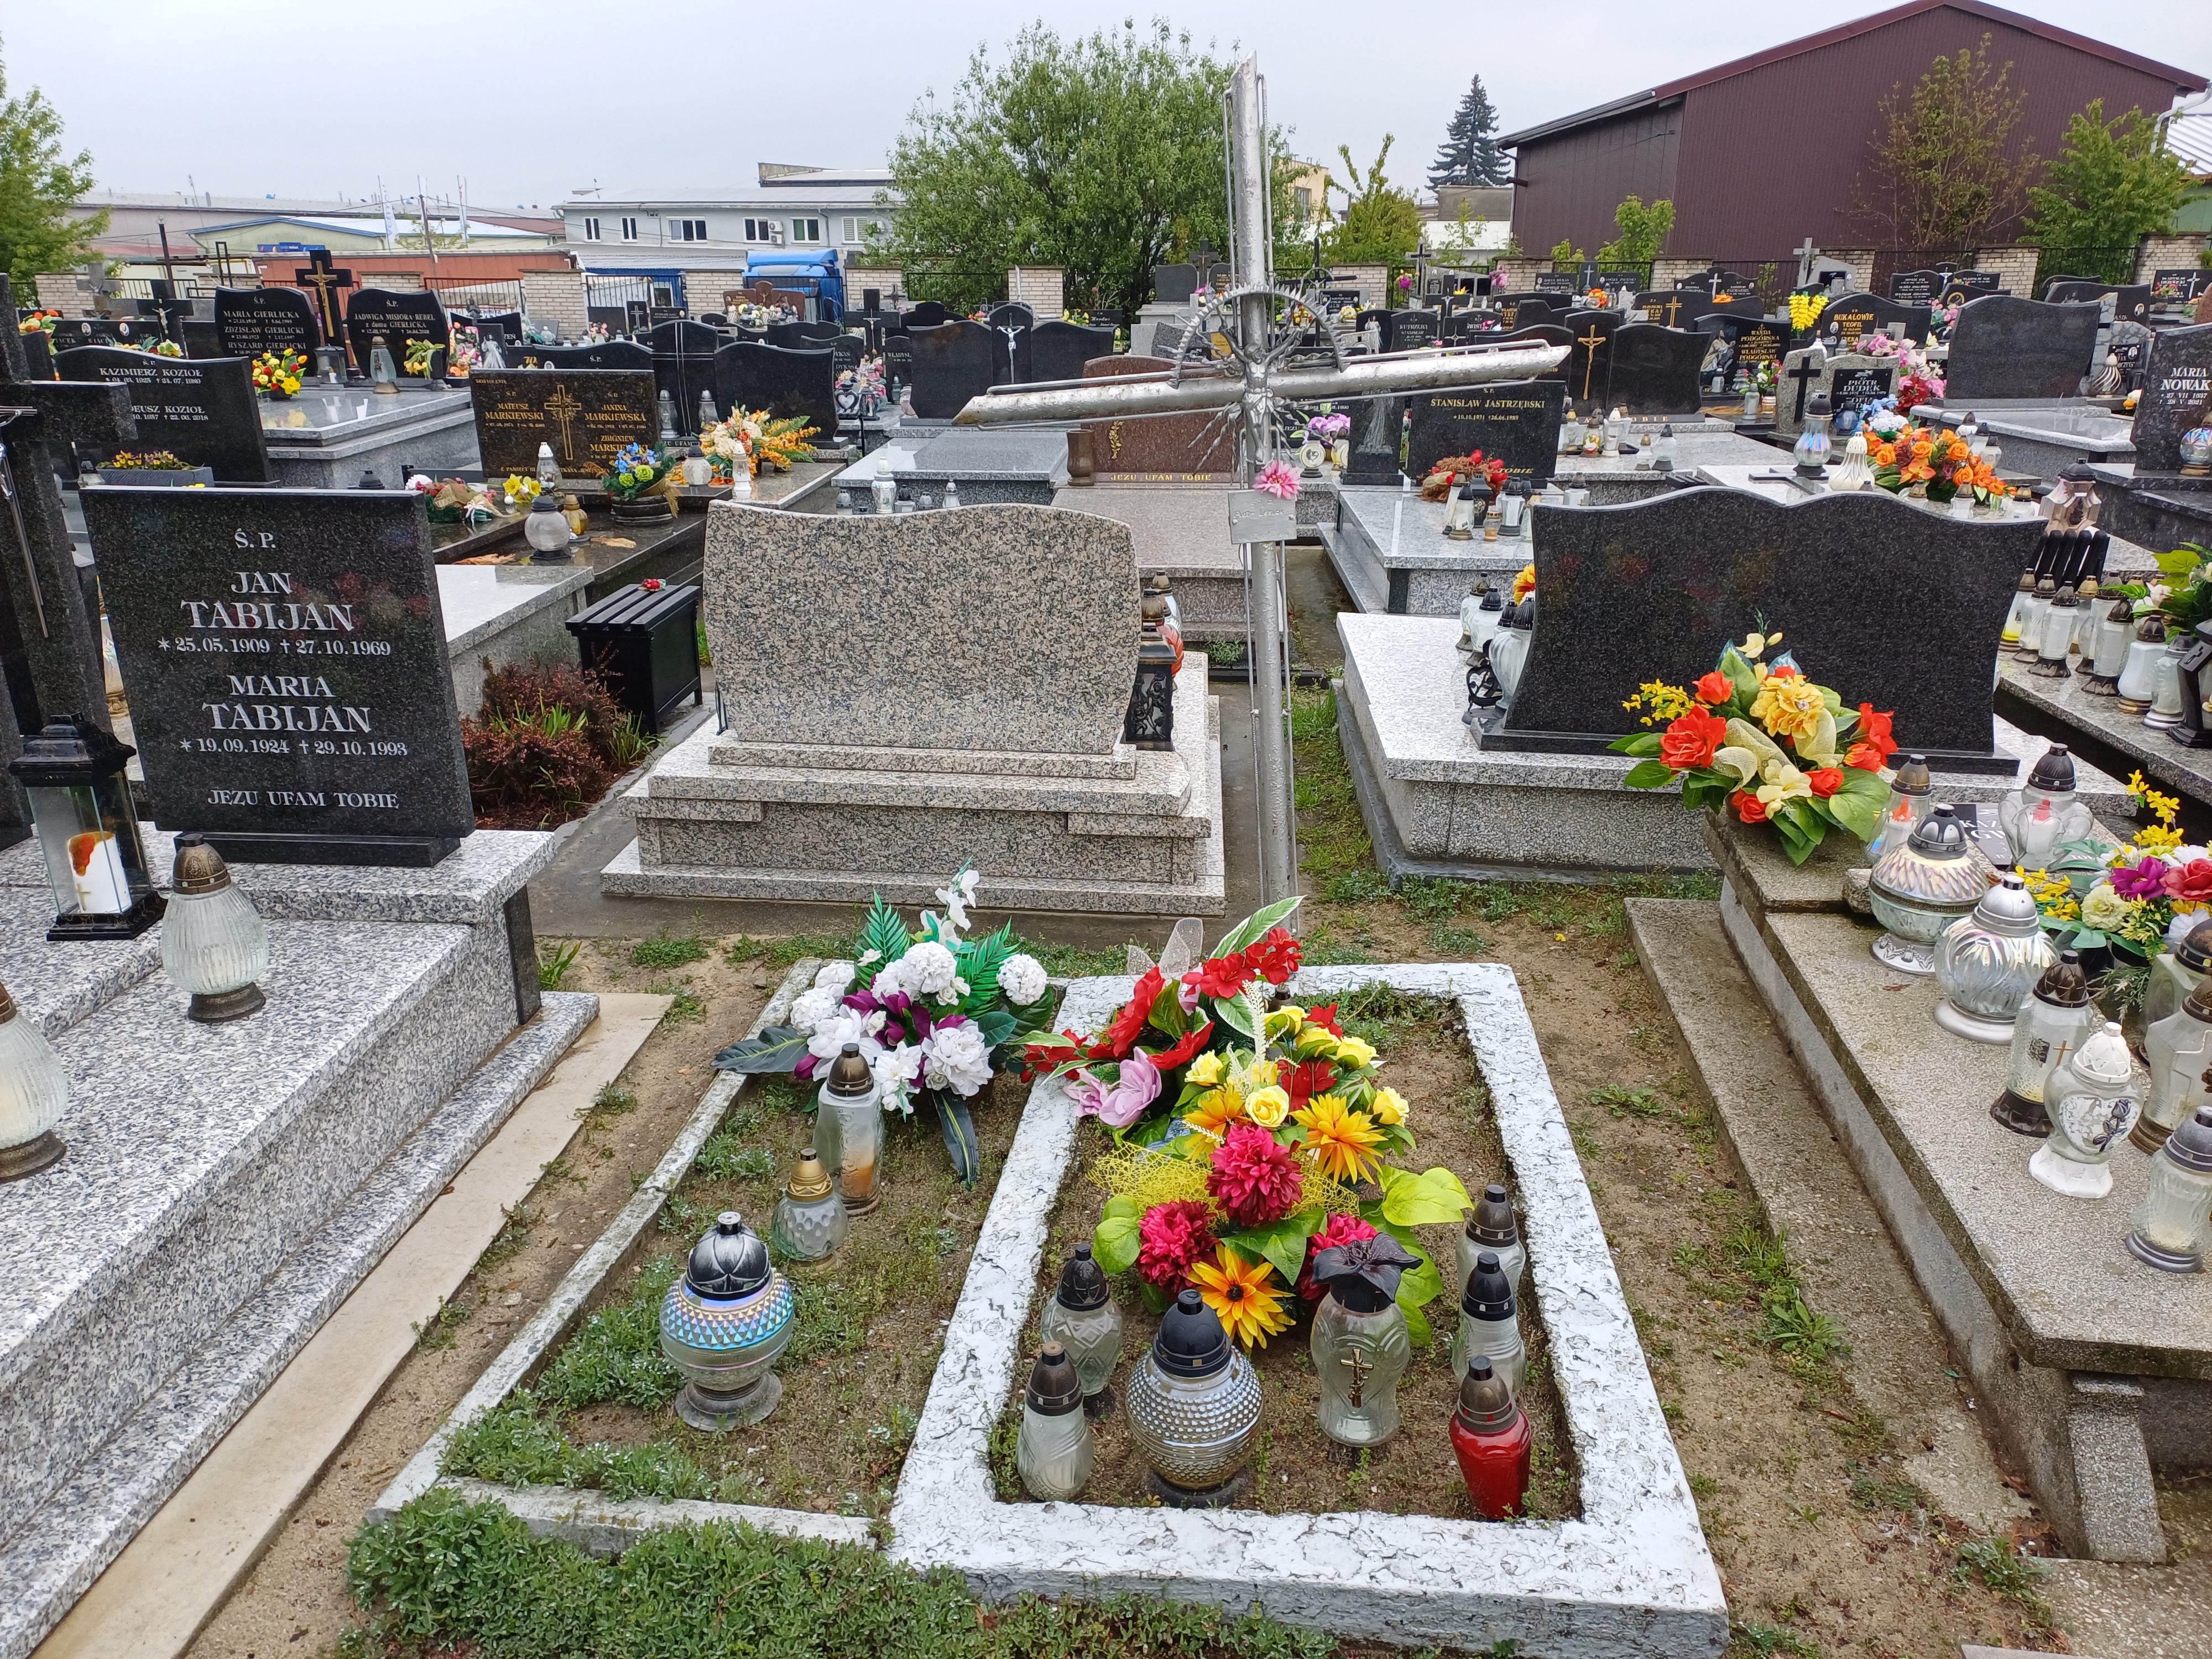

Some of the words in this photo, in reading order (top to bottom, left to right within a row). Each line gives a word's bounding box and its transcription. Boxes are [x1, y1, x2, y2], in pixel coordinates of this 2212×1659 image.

[99, 368, 158, 376] KAZIMIERZ
[162, 369, 203, 377] KOZIOŁ
[2171, 367, 2209, 377] MARIA
[2160, 379, 2212, 390] NOWAK
[164, 405, 205, 414] KOZIOŁ
[485, 411, 544, 420] MARKIEWSKI
[584, 413, 646, 421] MARKIEWSKA
[589, 444, 648, 452] MARKIEKI
[258, 532, 276, 549] P.
[231, 571, 292, 594] JAN
[180, 599, 355, 632] TABIJAN
[175, 637, 270, 653] 25.05.1909
[295, 639, 391, 656] 27.10.1969
[227, 675, 337, 698] MARIA
[201, 702, 373, 733] TABIJAN
[196, 738, 290, 754] 19.09.1924
[314, 740, 408, 757] 29.10.1993
[207, 789, 258, 806] JEZU
[267, 790, 327, 806] UFAM
[333, 792, 399, 809] TOBIE
